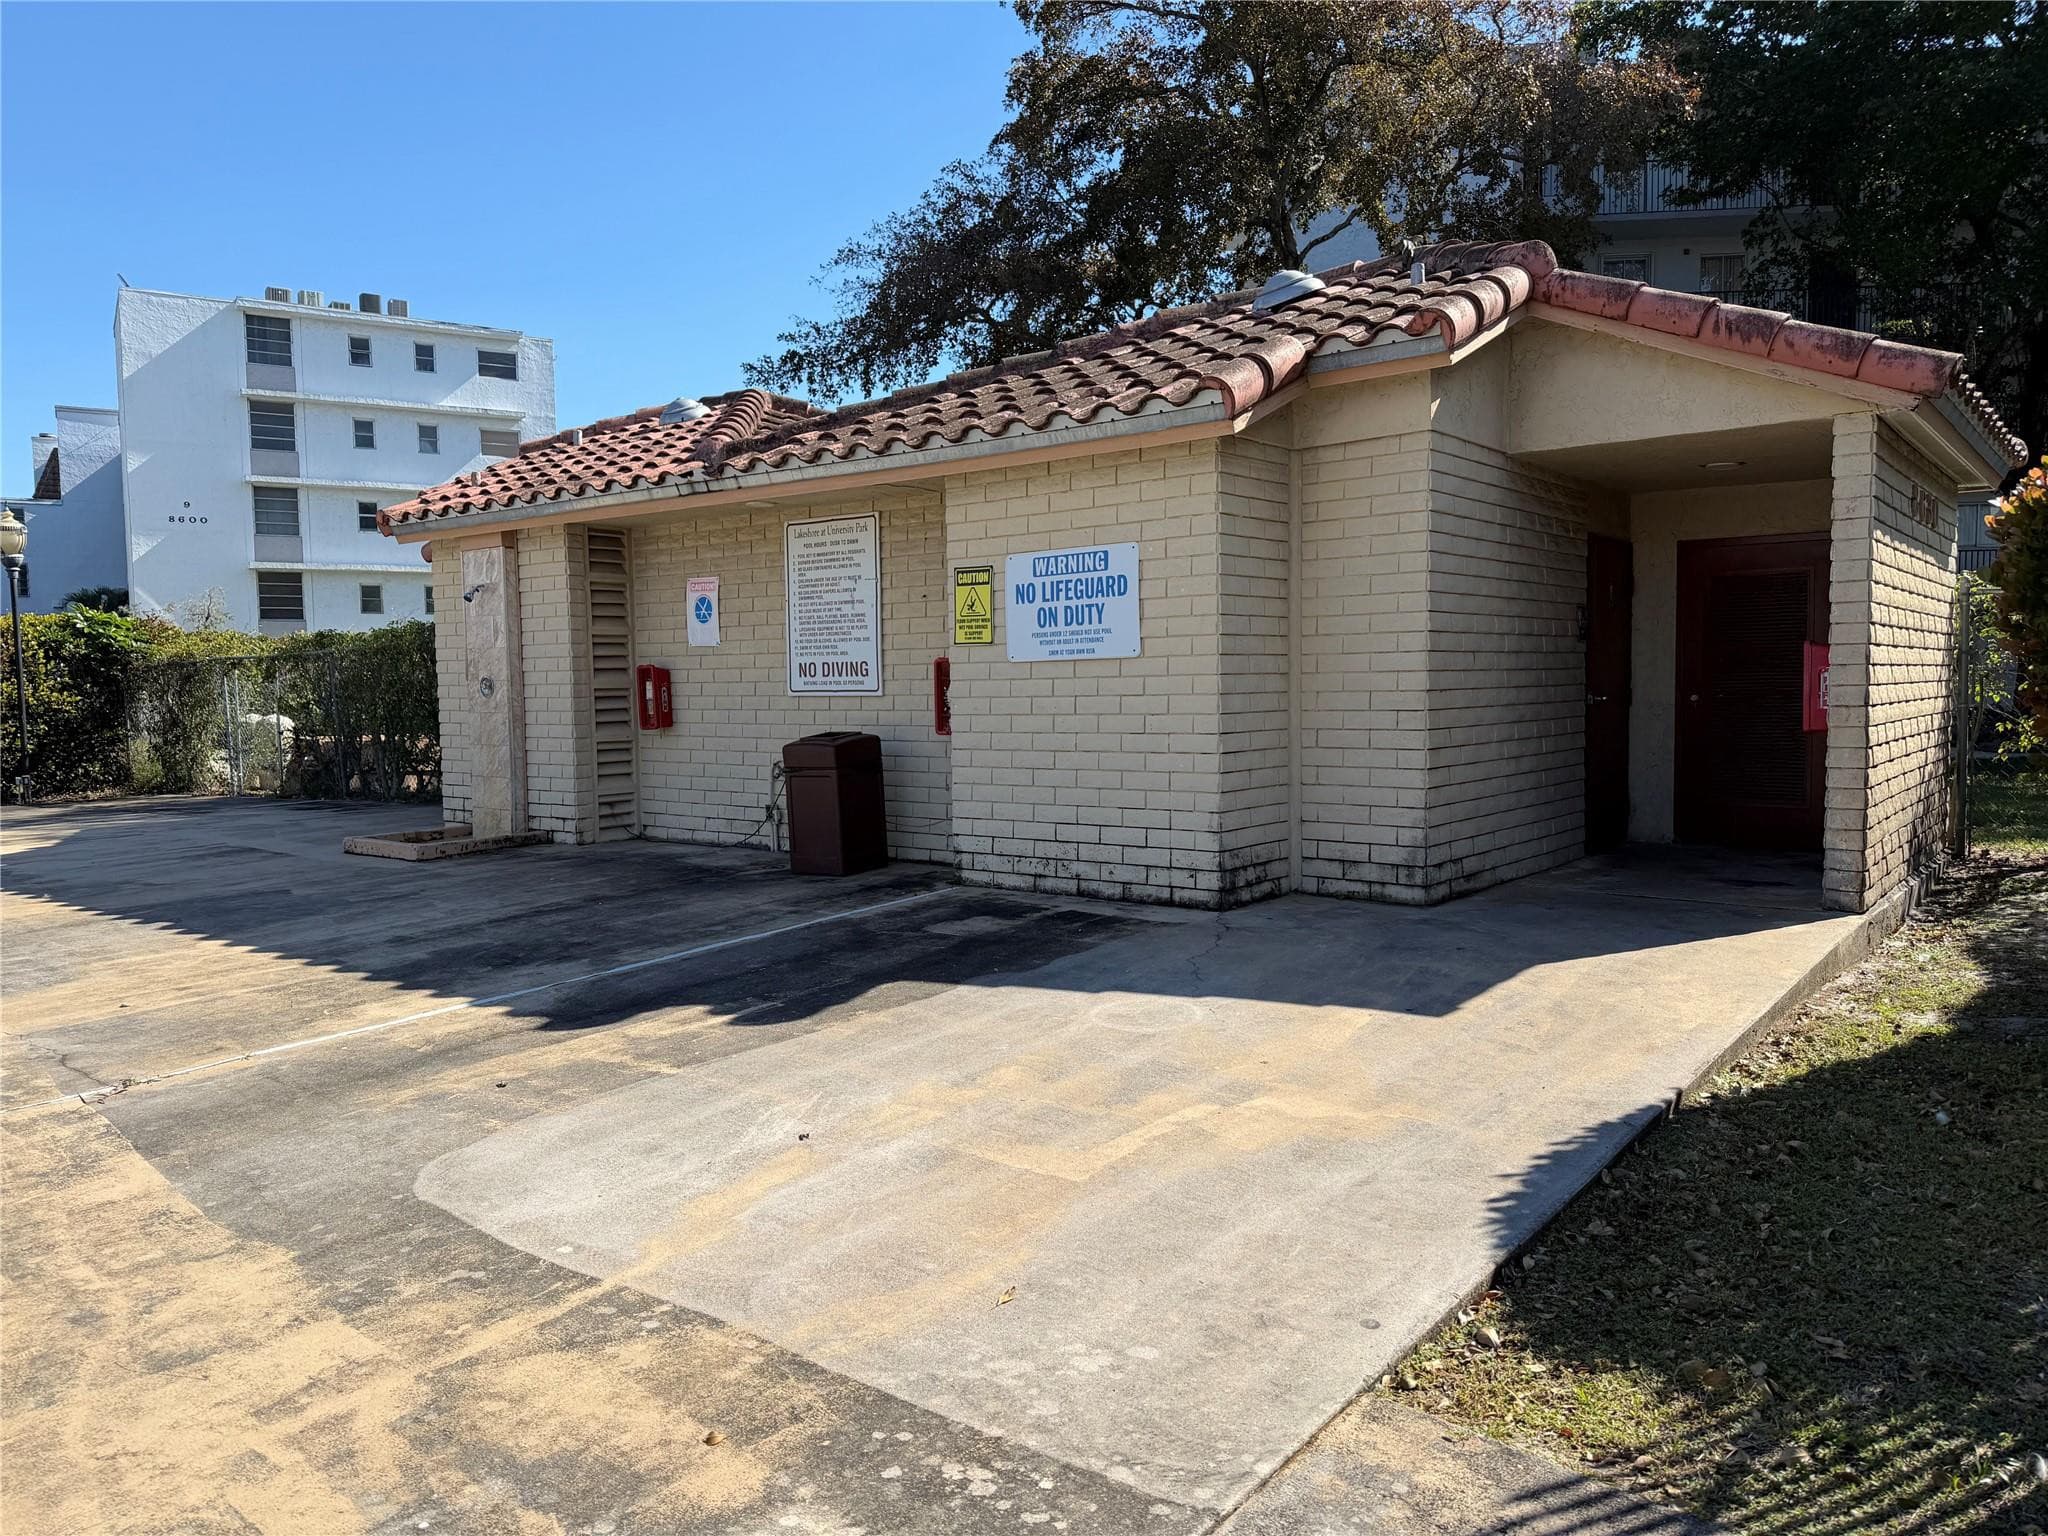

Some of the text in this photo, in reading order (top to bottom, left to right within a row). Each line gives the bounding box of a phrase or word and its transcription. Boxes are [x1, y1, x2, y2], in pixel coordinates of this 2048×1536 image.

[169, 516, 208, 524] 8600
[794, 528, 819, 538] Lakeshore
[827, 525, 854, 535] University
[856, 522, 868, 532] Park
[1034, 552, 1105, 577] WARNING
[958, 572, 989, 584] CAUTION
[1015, 574, 1128, 605] NO LIFEGUARD
[1037, 603, 1105, 628] ON DUTY
[799, 661, 869, 678] NO DIVING
